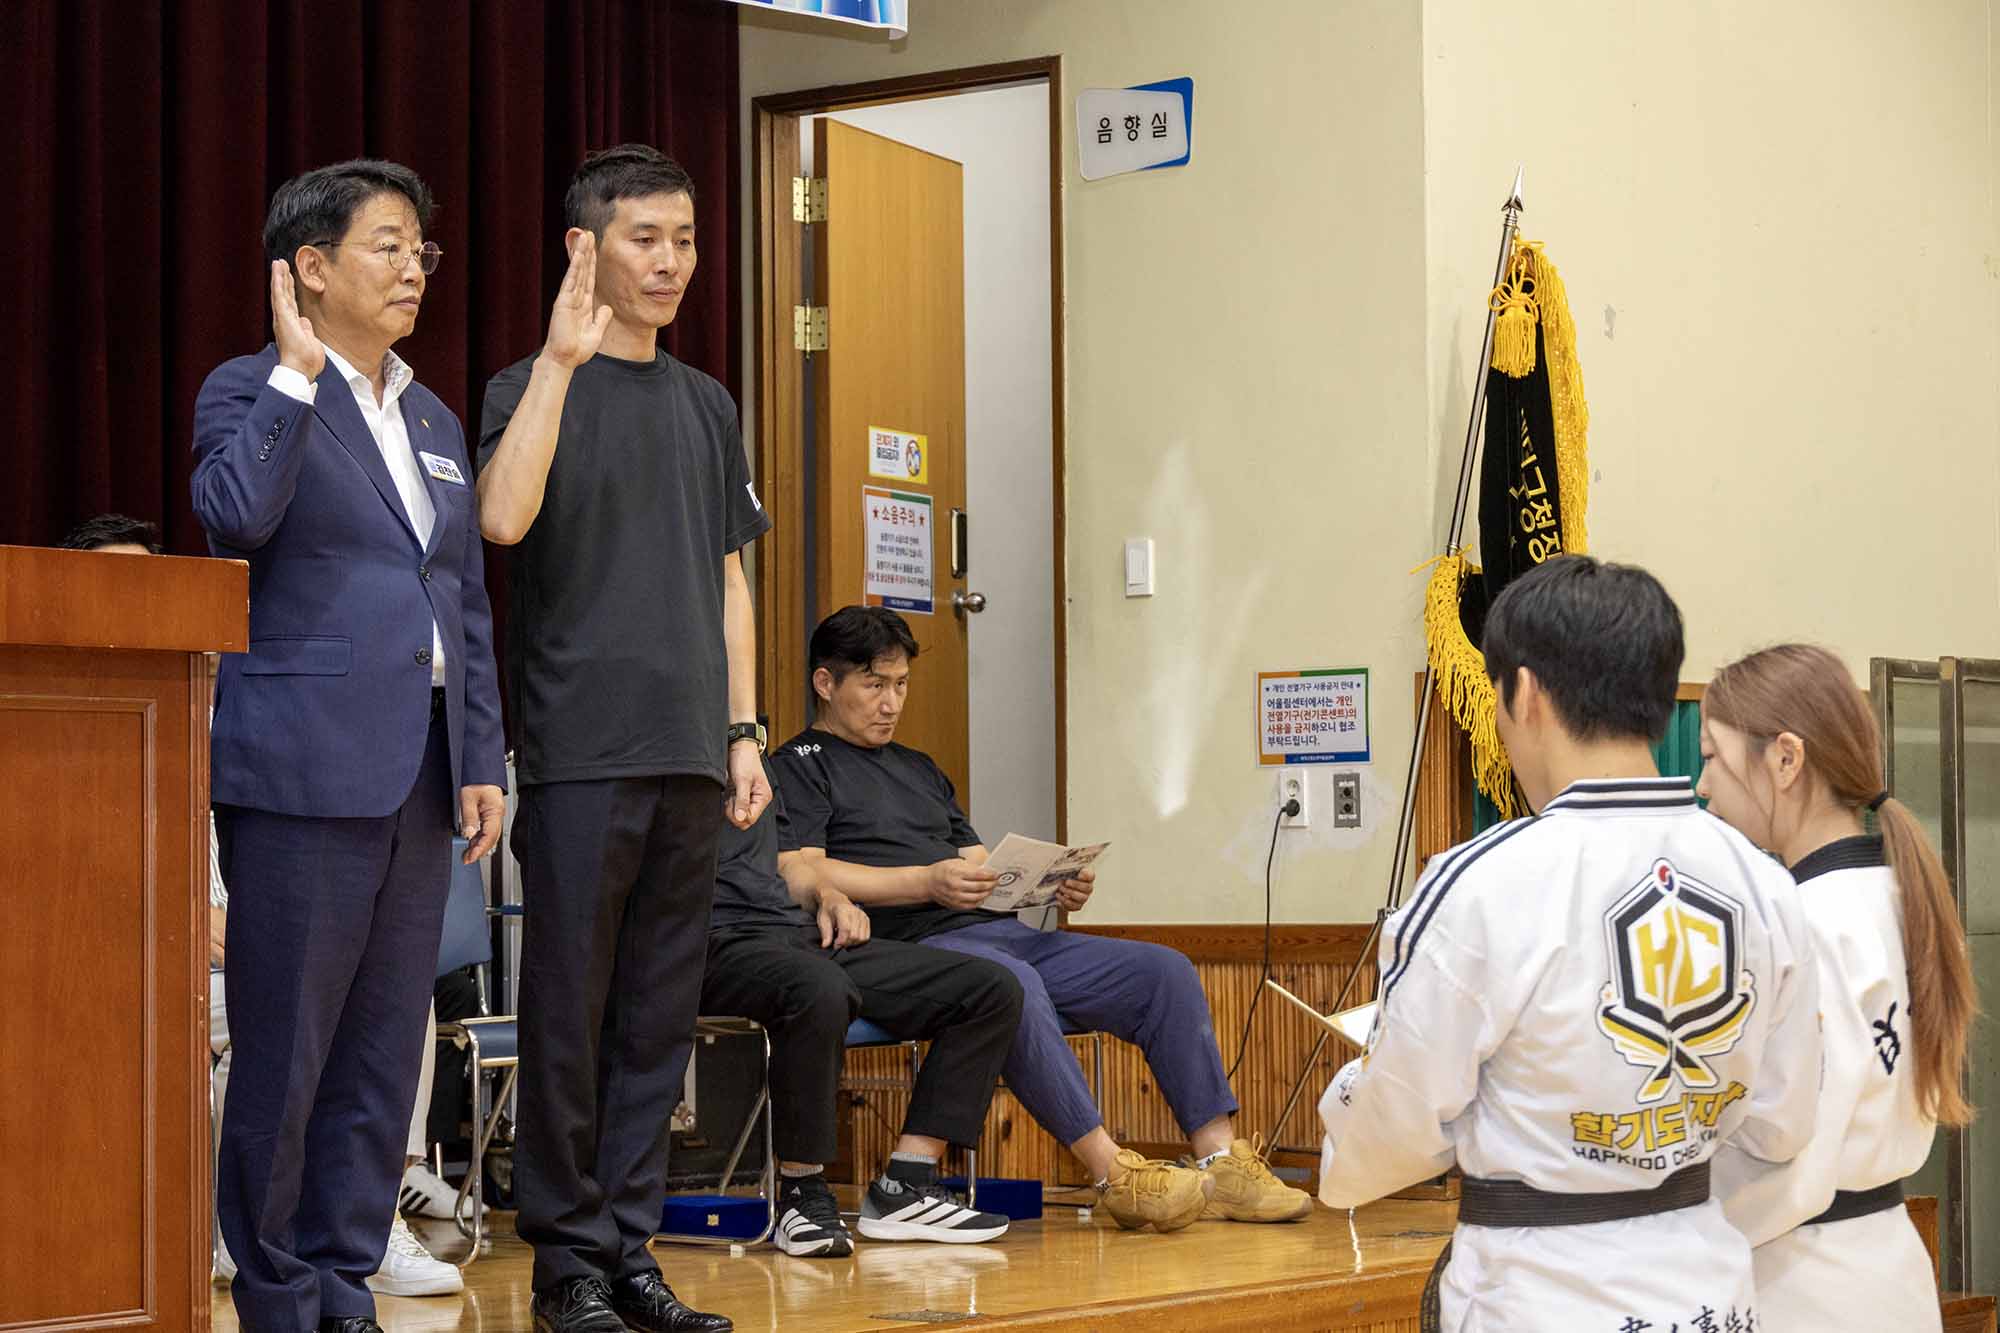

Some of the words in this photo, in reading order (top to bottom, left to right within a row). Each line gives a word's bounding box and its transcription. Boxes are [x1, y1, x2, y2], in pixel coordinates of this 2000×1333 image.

[882, 505, 915, 528] 소음주의
[1335, 695, 1352, 706] 개인
[1267, 722, 1291, 735] 사용을
[1294, 721, 1336, 733] 금지하오니
[1339, 720, 1356, 732] 협조
[1267, 735, 1320, 747] 부탁드립니다.
